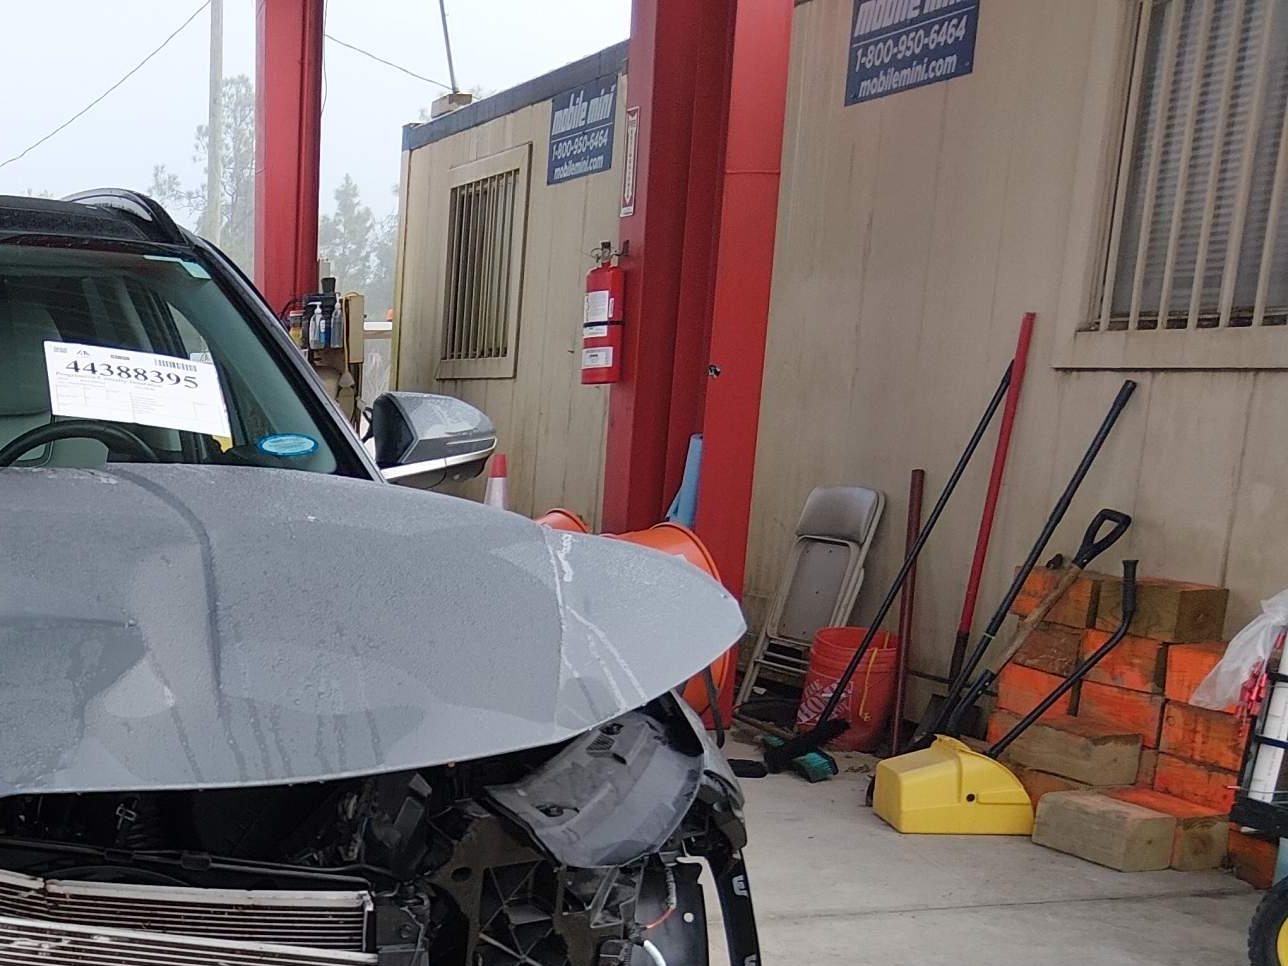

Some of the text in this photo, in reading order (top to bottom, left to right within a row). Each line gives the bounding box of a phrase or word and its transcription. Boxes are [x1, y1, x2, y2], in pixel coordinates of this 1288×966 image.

[855, 15, 968, 72] 1-800-950-6464
[858, 54, 958, 98] mobilemini.com
[552, 84, 616, 136] mobile mini
[552, 128, 609, 161] 1-800-950-6464
[554, 155, 604, 180] mobilemini.com
[65, 360, 199, 389] 44388395
